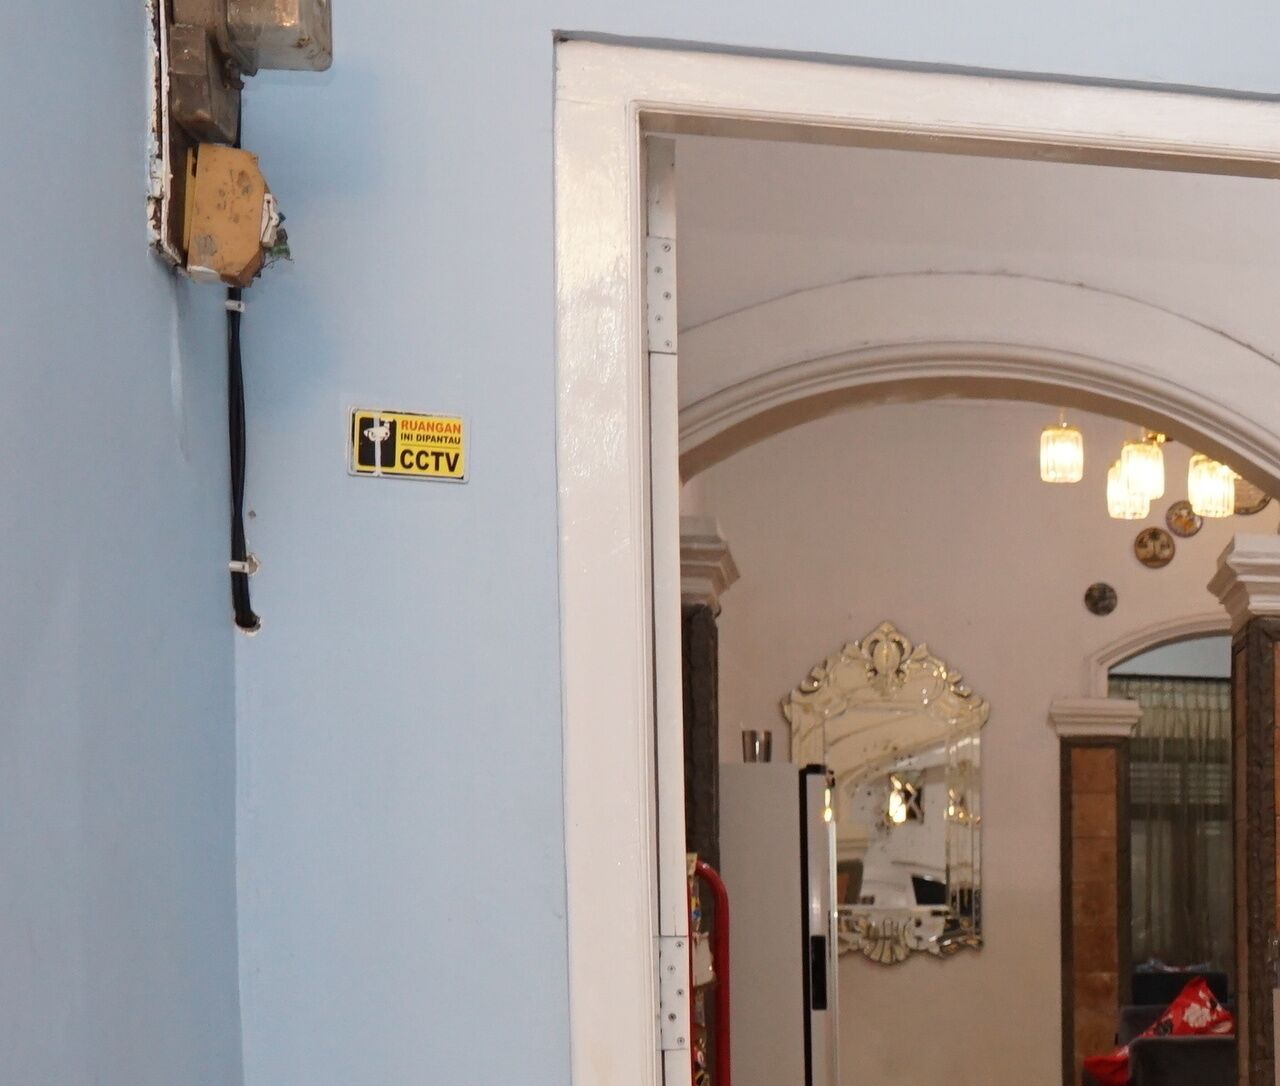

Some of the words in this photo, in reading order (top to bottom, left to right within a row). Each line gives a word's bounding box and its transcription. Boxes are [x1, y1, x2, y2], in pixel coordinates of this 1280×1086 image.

[401, 420, 461, 434] RUANGAN
[401, 433, 413, 441] INI
[416, 434, 460, 445] DIPANTAU
[400, 449, 459, 472] CCTV
